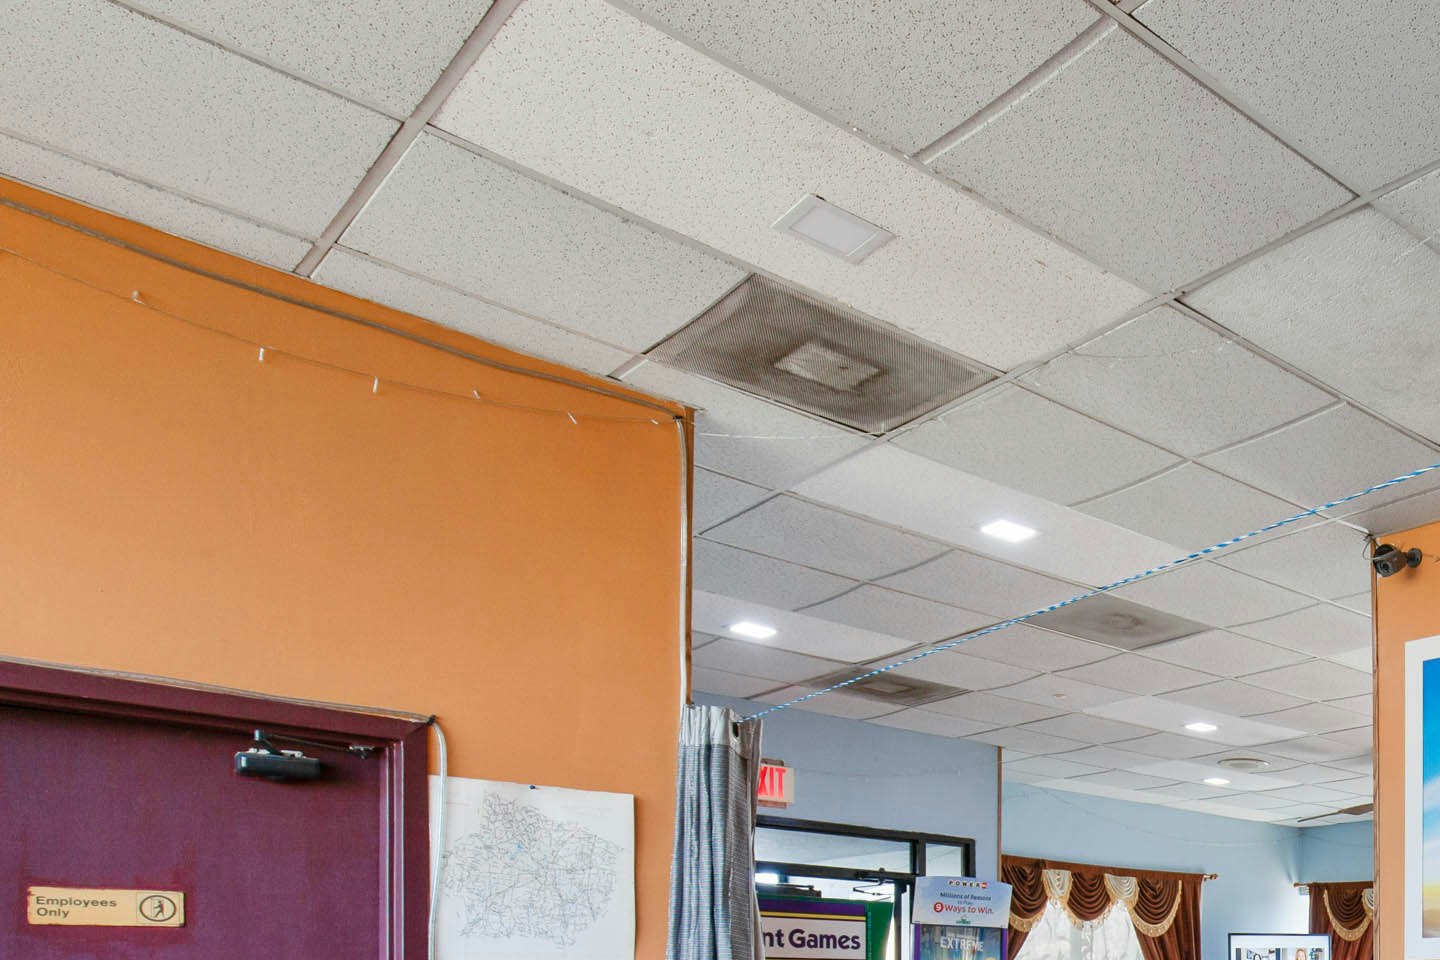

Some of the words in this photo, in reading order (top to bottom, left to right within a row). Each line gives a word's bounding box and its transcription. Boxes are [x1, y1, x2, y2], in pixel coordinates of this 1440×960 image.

[758, 766, 787, 799] XIT
[36, 896, 117, 907] Employees
[37, 908, 69, 918] Only
[935, 903, 942, 911] 9
[945, 904, 966, 913] Ways
[968, 905, 976, 913] to
[788, 928, 861, 949] Games
